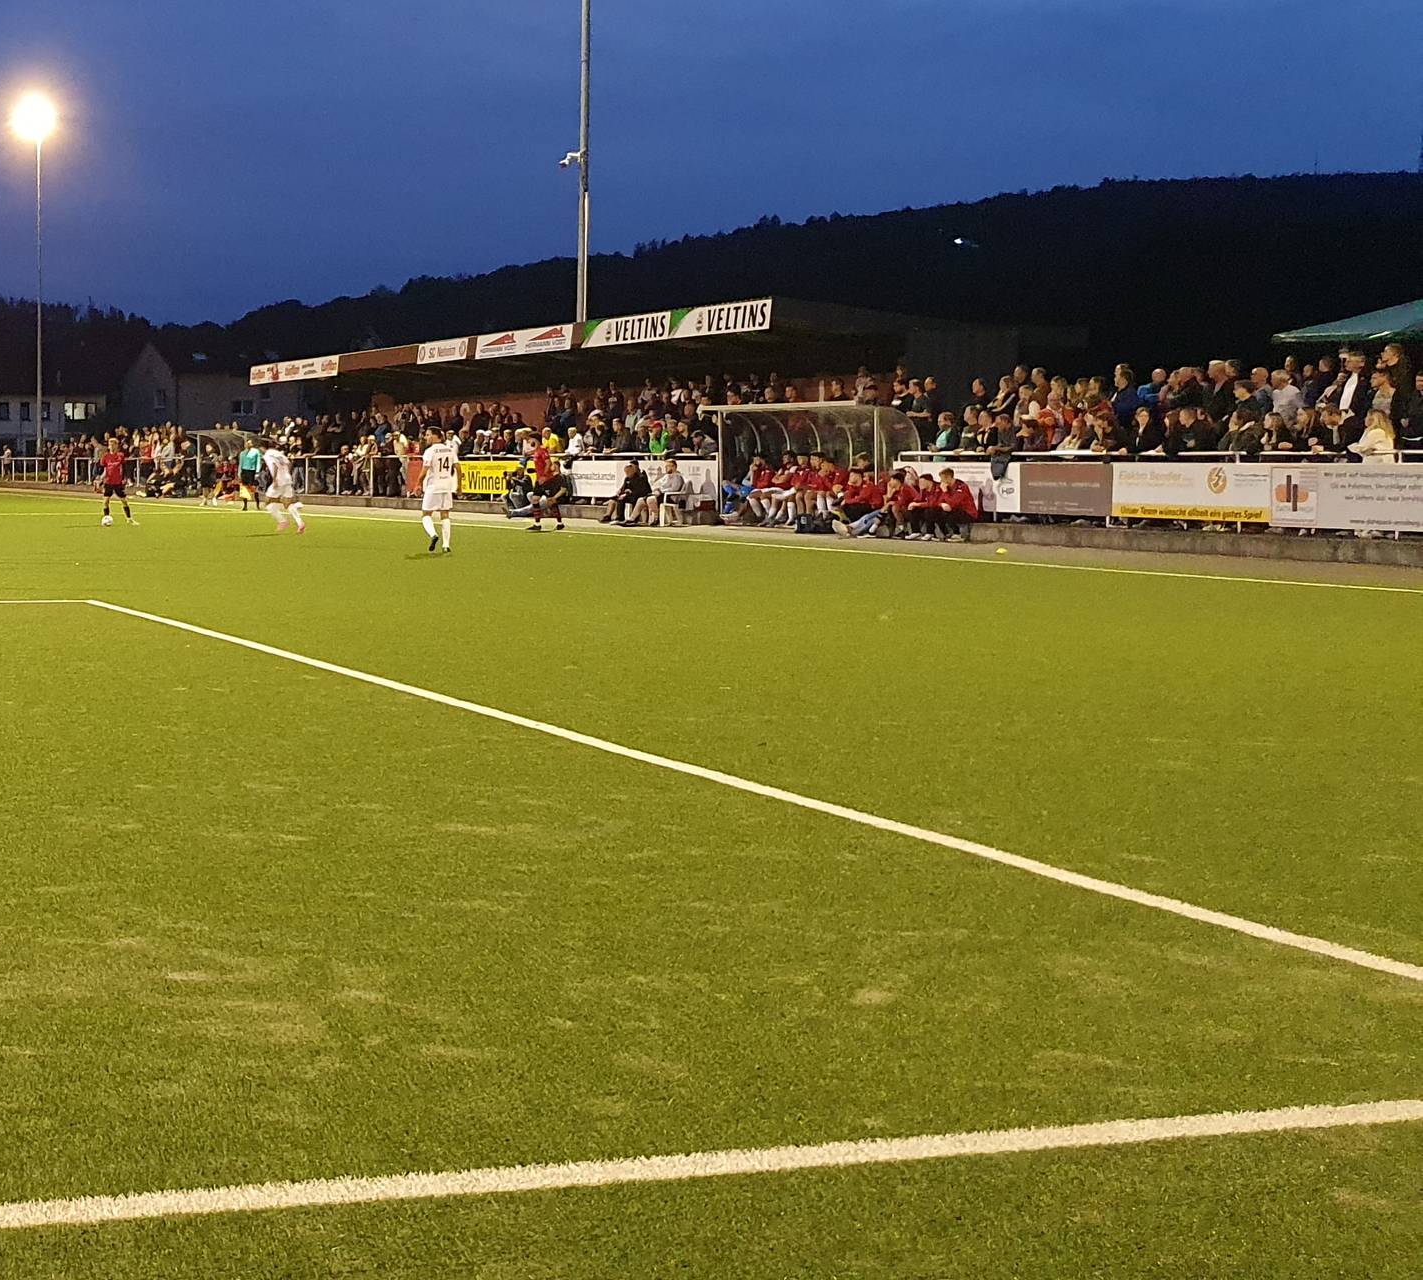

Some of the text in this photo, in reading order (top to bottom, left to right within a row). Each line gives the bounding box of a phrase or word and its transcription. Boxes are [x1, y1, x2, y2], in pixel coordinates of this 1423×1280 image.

[615, 315, 667, 342] VELTINS
[707, 303, 768, 332] VELTINS
[438, 456, 450, 473] 14
